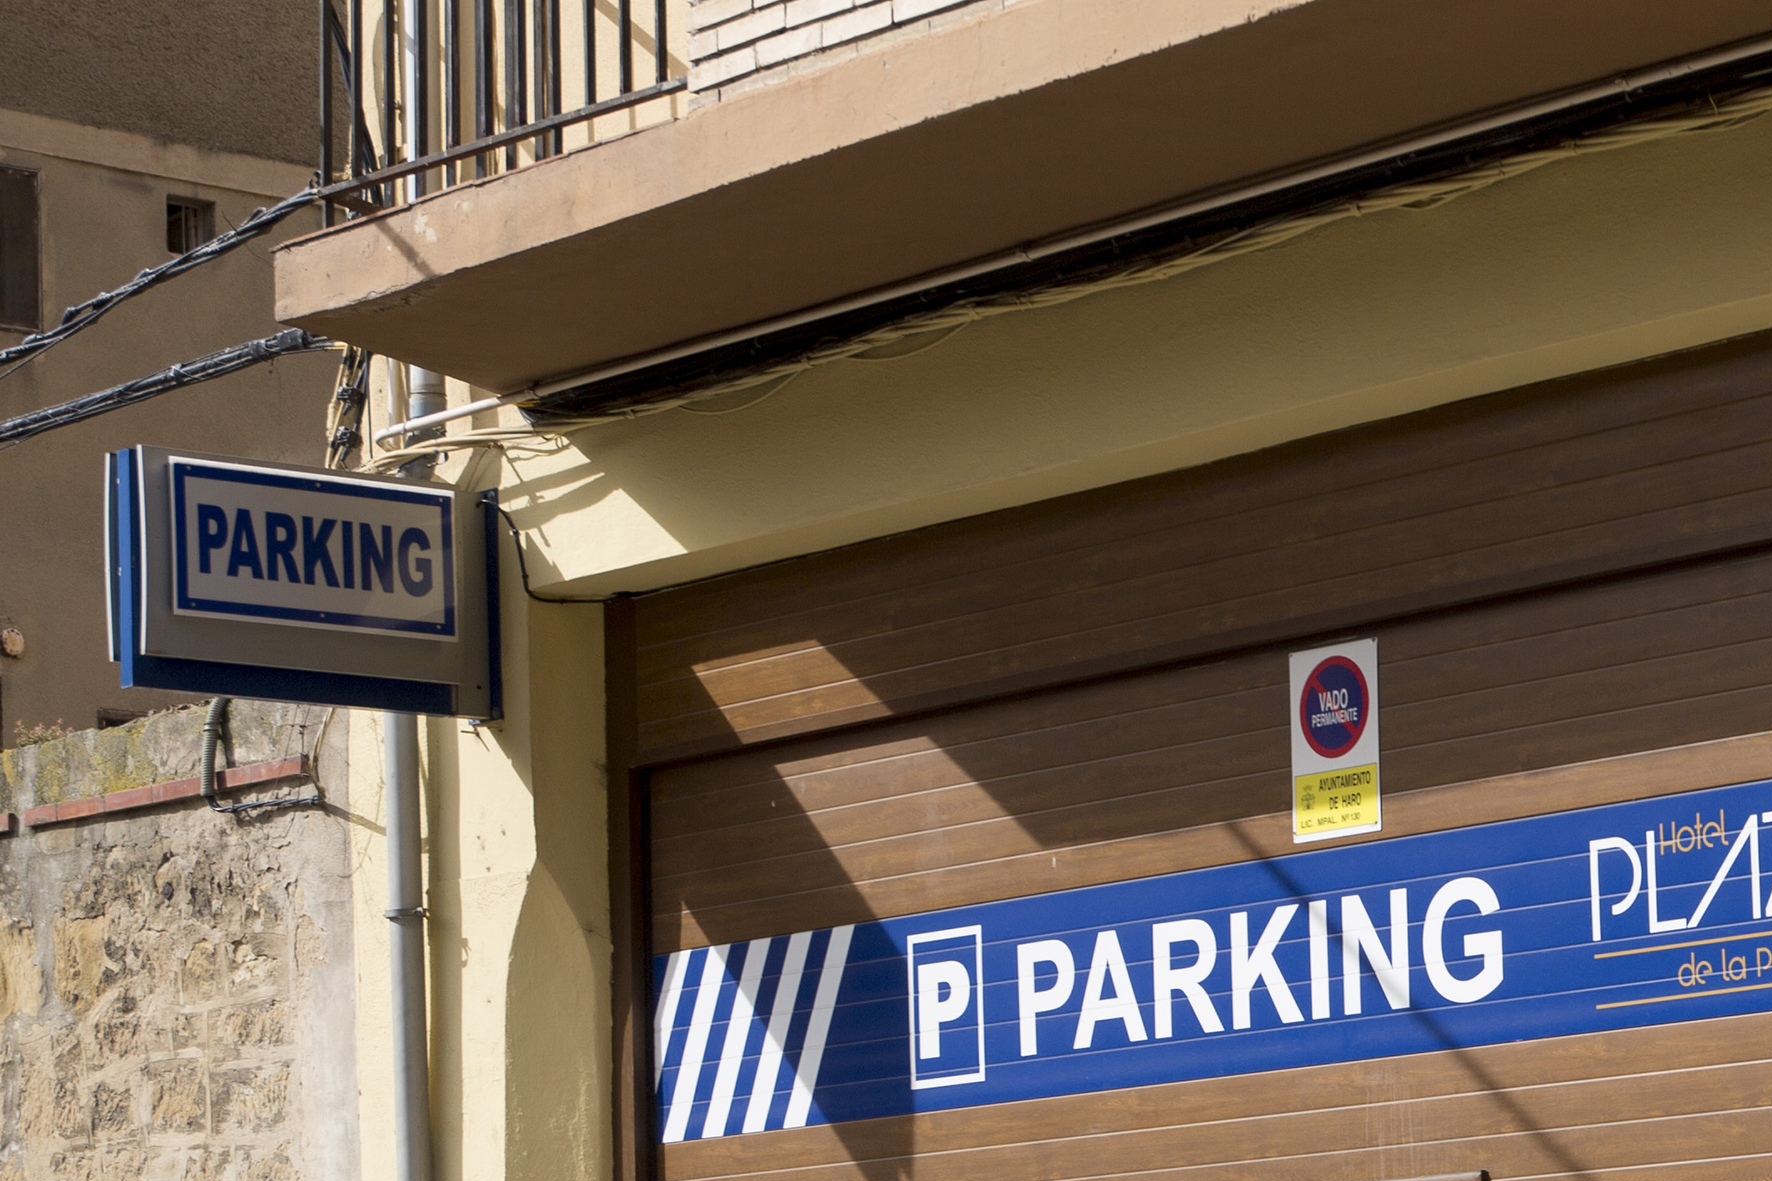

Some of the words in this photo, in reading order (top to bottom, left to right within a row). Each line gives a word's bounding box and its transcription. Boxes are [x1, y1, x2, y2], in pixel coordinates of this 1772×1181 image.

[196, 503, 434, 598] PARKING
[1318, 688, 1349, 712] VADO
[1311, 707, 1359, 728] PERMANENTE
[1319, 770, 1371, 792] AYUNTAMIENTO
[1329, 796, 1339, 810] DE
[1341, 792, 1362, 808] HARO
[1659, 809, 1729, 856] Hotel
[917, 960, 971, 1060] P
[1016, 876, 1504, 1057] PARKING
[1678, 952, 1714, 987] de
[1721, 949, 1747, 982] la
